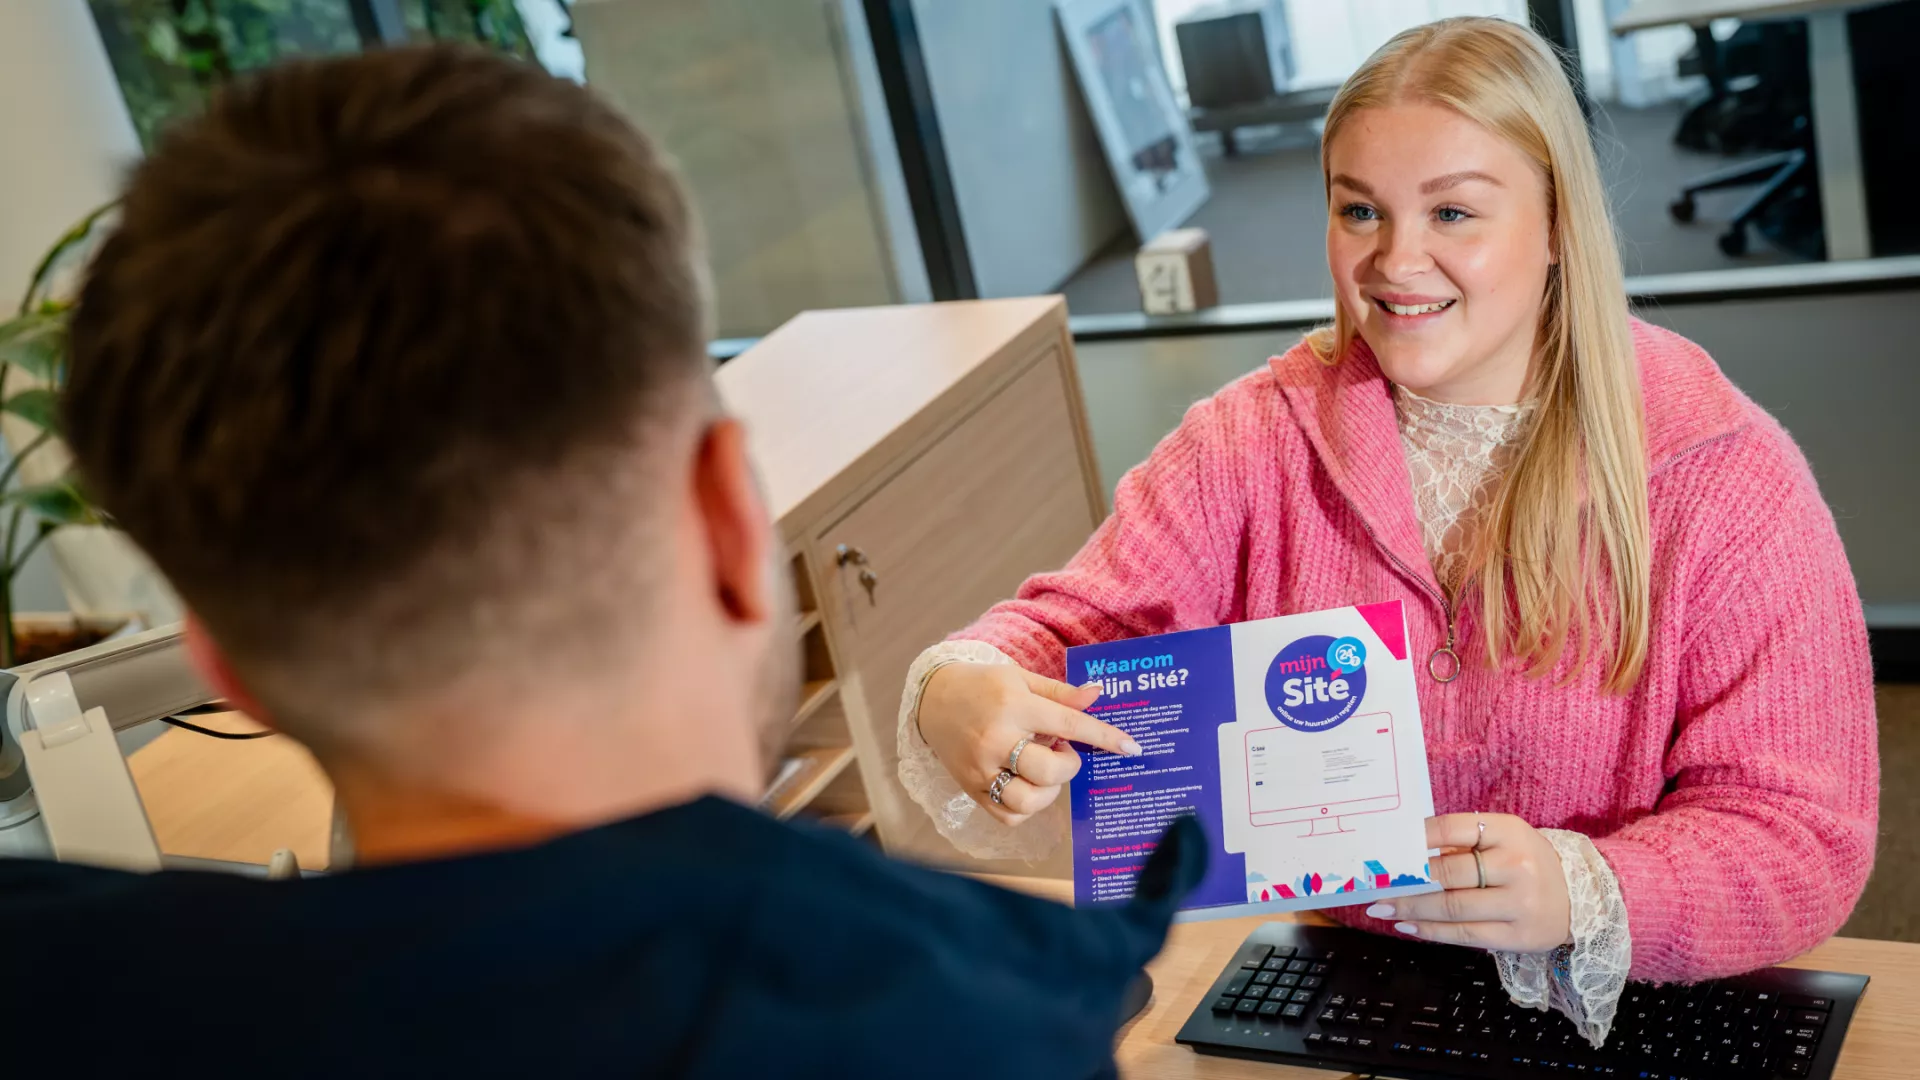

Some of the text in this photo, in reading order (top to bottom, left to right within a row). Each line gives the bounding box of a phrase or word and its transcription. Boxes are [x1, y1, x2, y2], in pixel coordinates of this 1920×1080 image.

[1339, 649, 1352, 660] 24
[1085, 654, 1174, 676] Waarom
[1280, 654, 1326, 674] mijn
[1138, 668, 1188, 690] Sité?
[1283, 668, 1349, 706] Sité
[1122, 700, 1150, 708] huurder
[1133, 712, 1160, 721] compliment
[1278, 706, 1294, 721] online
[1305, 714, 1340, 726] huurzaken
[1339, 696, 1357, 716] regelen
[1158, 728, 1190, 737] bankrekening
[1104, 825, 1134, 833] mogelijkheid
[1092, 866, 1131, 875] Vervolgens
